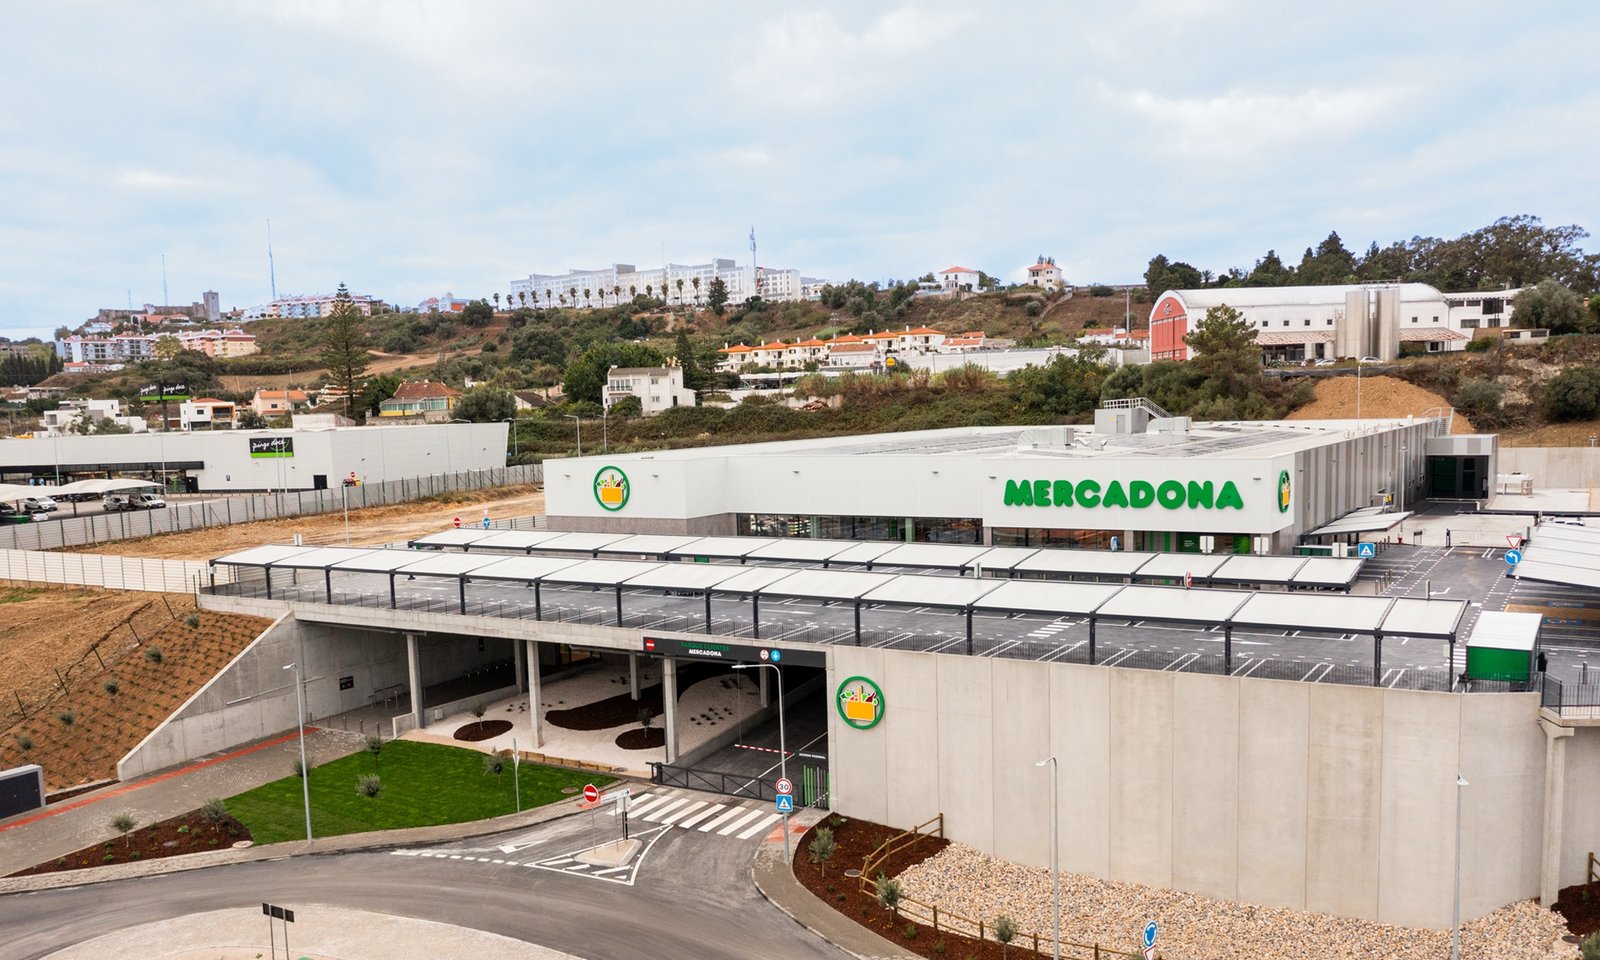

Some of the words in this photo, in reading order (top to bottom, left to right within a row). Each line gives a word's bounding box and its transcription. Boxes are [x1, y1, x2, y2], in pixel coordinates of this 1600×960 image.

[252, 441, 270, 452] pingo
[1003, 479, 1243, 510] MERCADONA
[688, 649, 722, 657] MERCADONA
